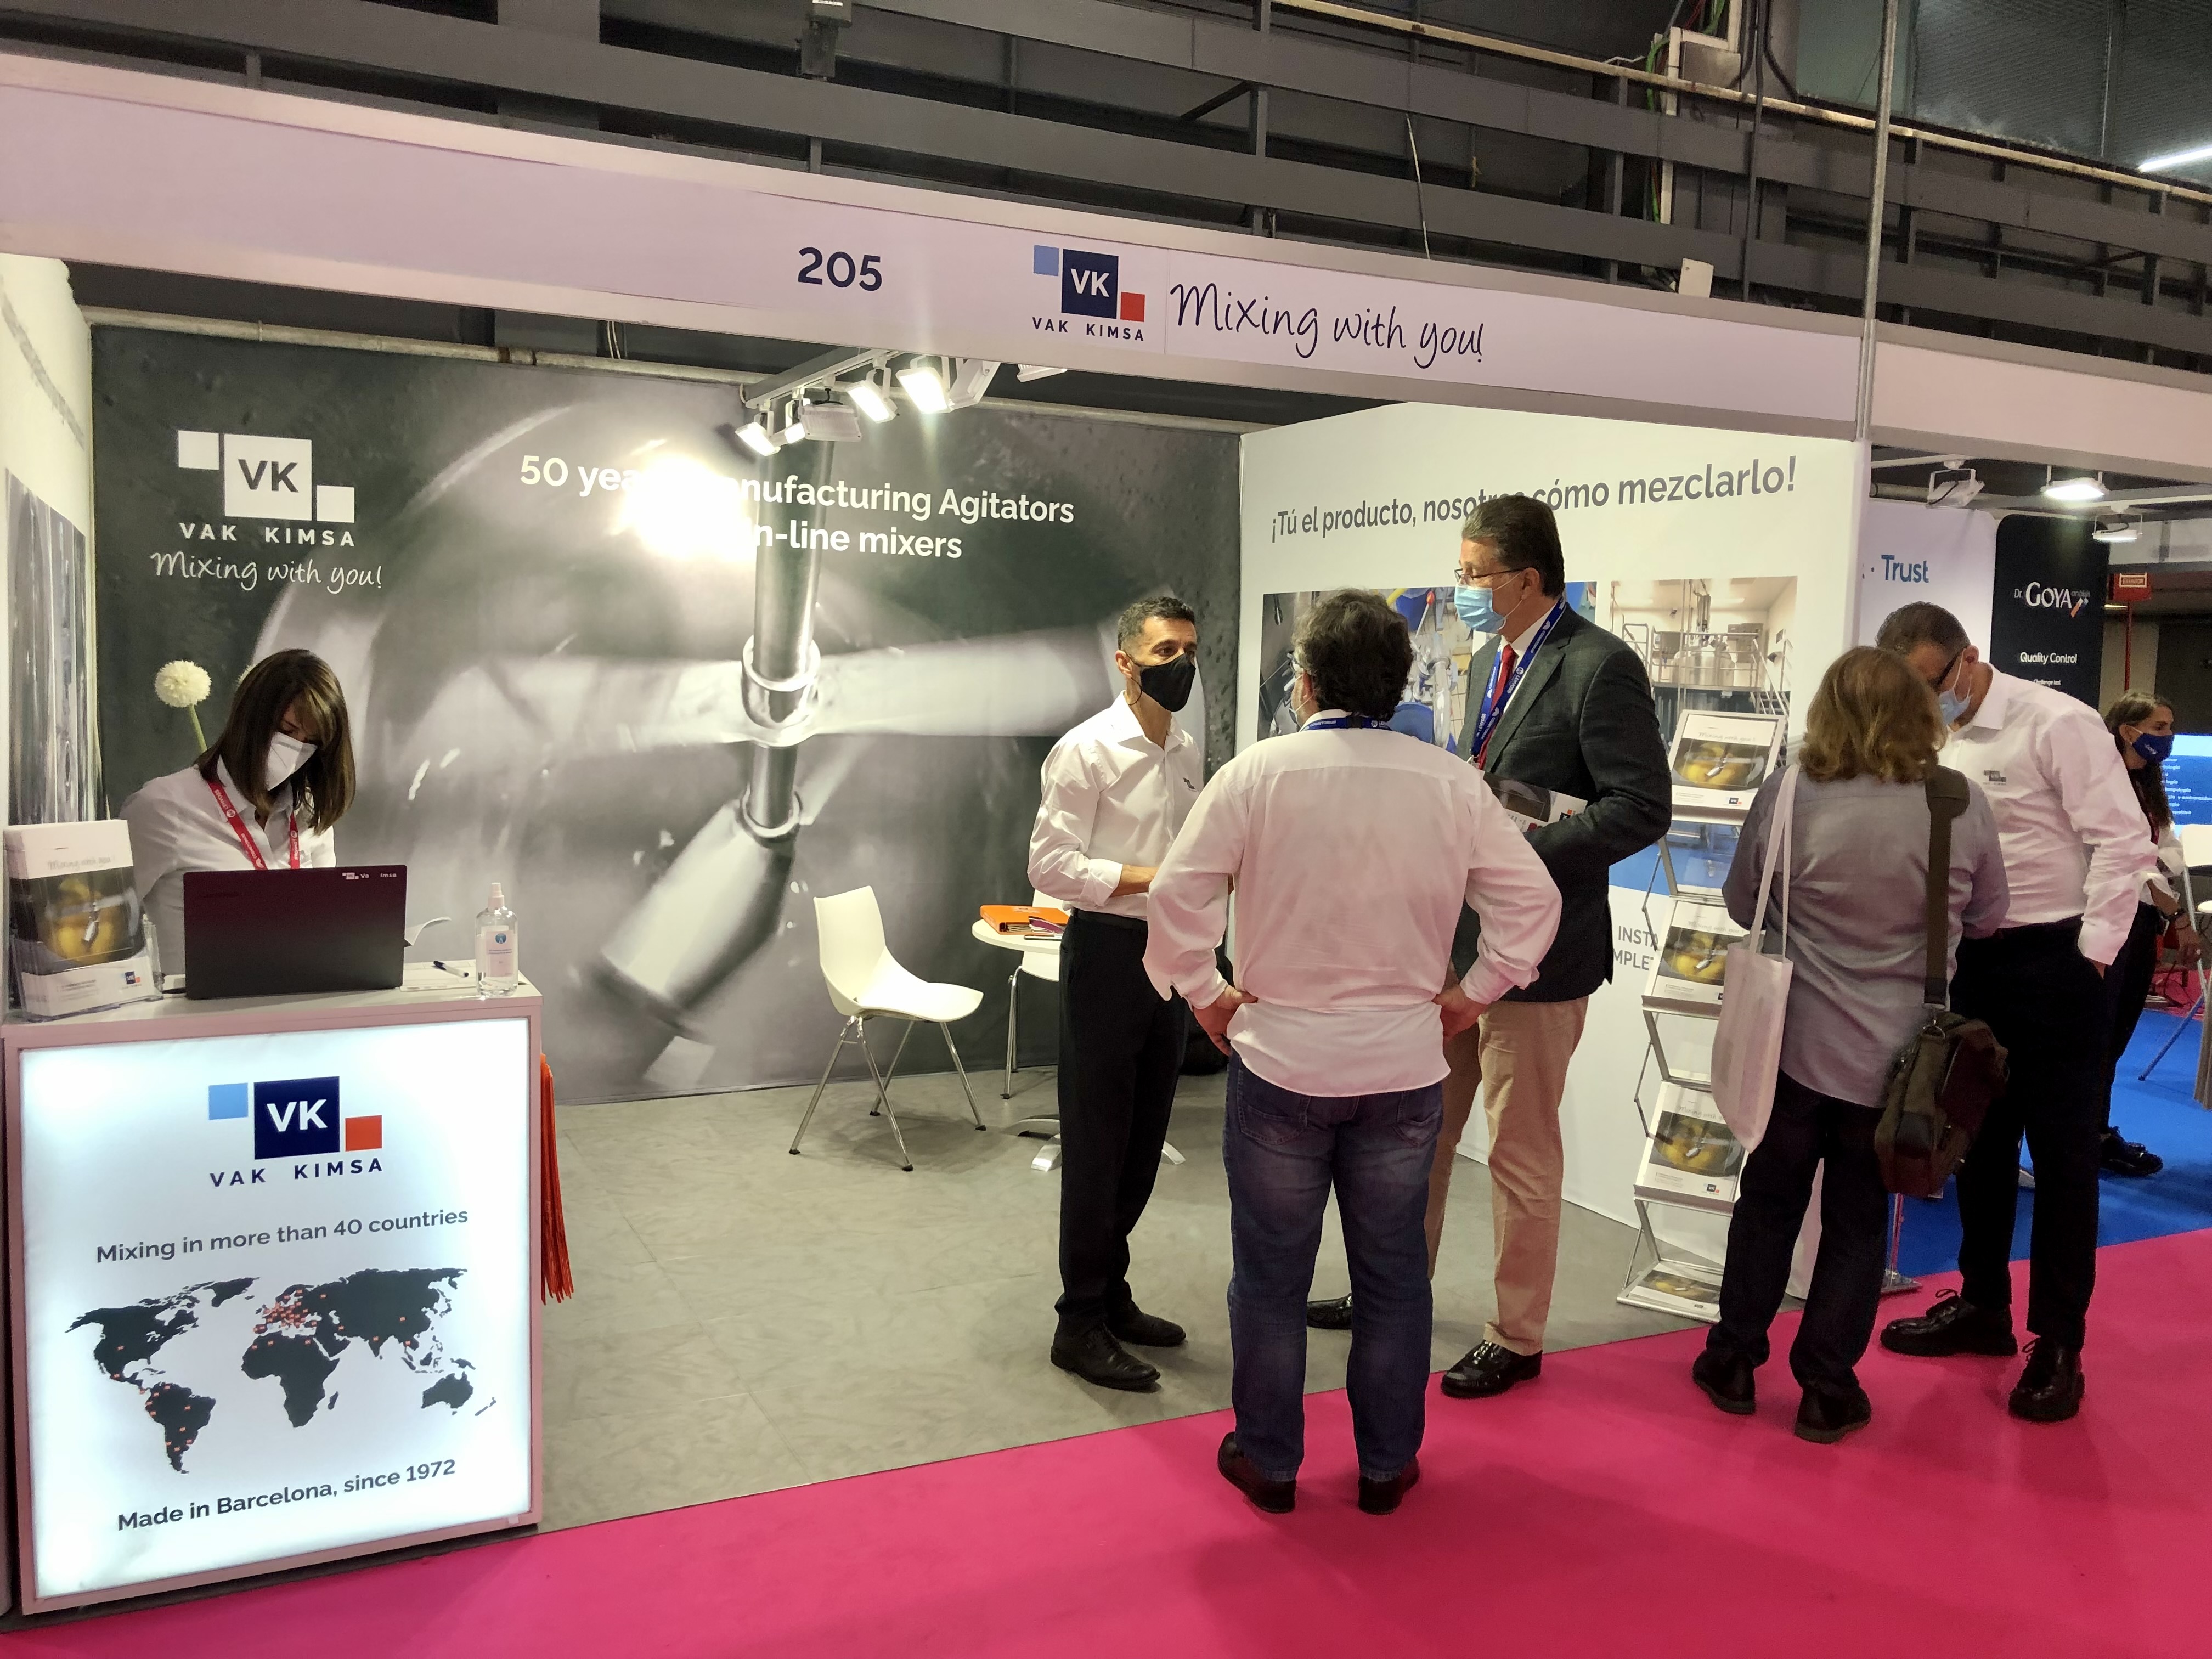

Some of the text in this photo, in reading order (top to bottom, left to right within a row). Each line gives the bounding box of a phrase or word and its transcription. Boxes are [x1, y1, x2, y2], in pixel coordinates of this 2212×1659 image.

[797, 247, 882, 291] 205
[1070, 268, 1109, 297] VK
[1032, 317, 1144, 341] VAK KIMSA
[1170, 283, 1483, 369] Mixing with you!
[238, 459, 299, 493] VK
[520, 455, 569, 487] 50
[732, 475, 932, 521] nufacturing
[939, 488, 1074, 524] Agitators
[1272, 509, 1297, 543] ¡Tú
[1302, 506, 1318, 533] el
[1322, 499, 1416, 538] producto,
[1618, 455, 1796, 505] mezclarlo!
[179, 523, 355, 547] VAK KIMSA
[754, 520, 963, 558] n-line mixers
[150, 551, 382, 595] Mixing with you!
[1881, 555, 1929, 583] Trust
[2020, 652, 2078, 665] Quality Control
[1613, 948, 1654, 970] MPLE
[267, 1099, 328, 1132] VK
[210, 1158, 382, 1187] VAK KIMSA
[97, 1210, 468, 1263] Mixing in more than 40 countries
[118, 1459, 455, 1531] Made in Barcelona, since 1972
